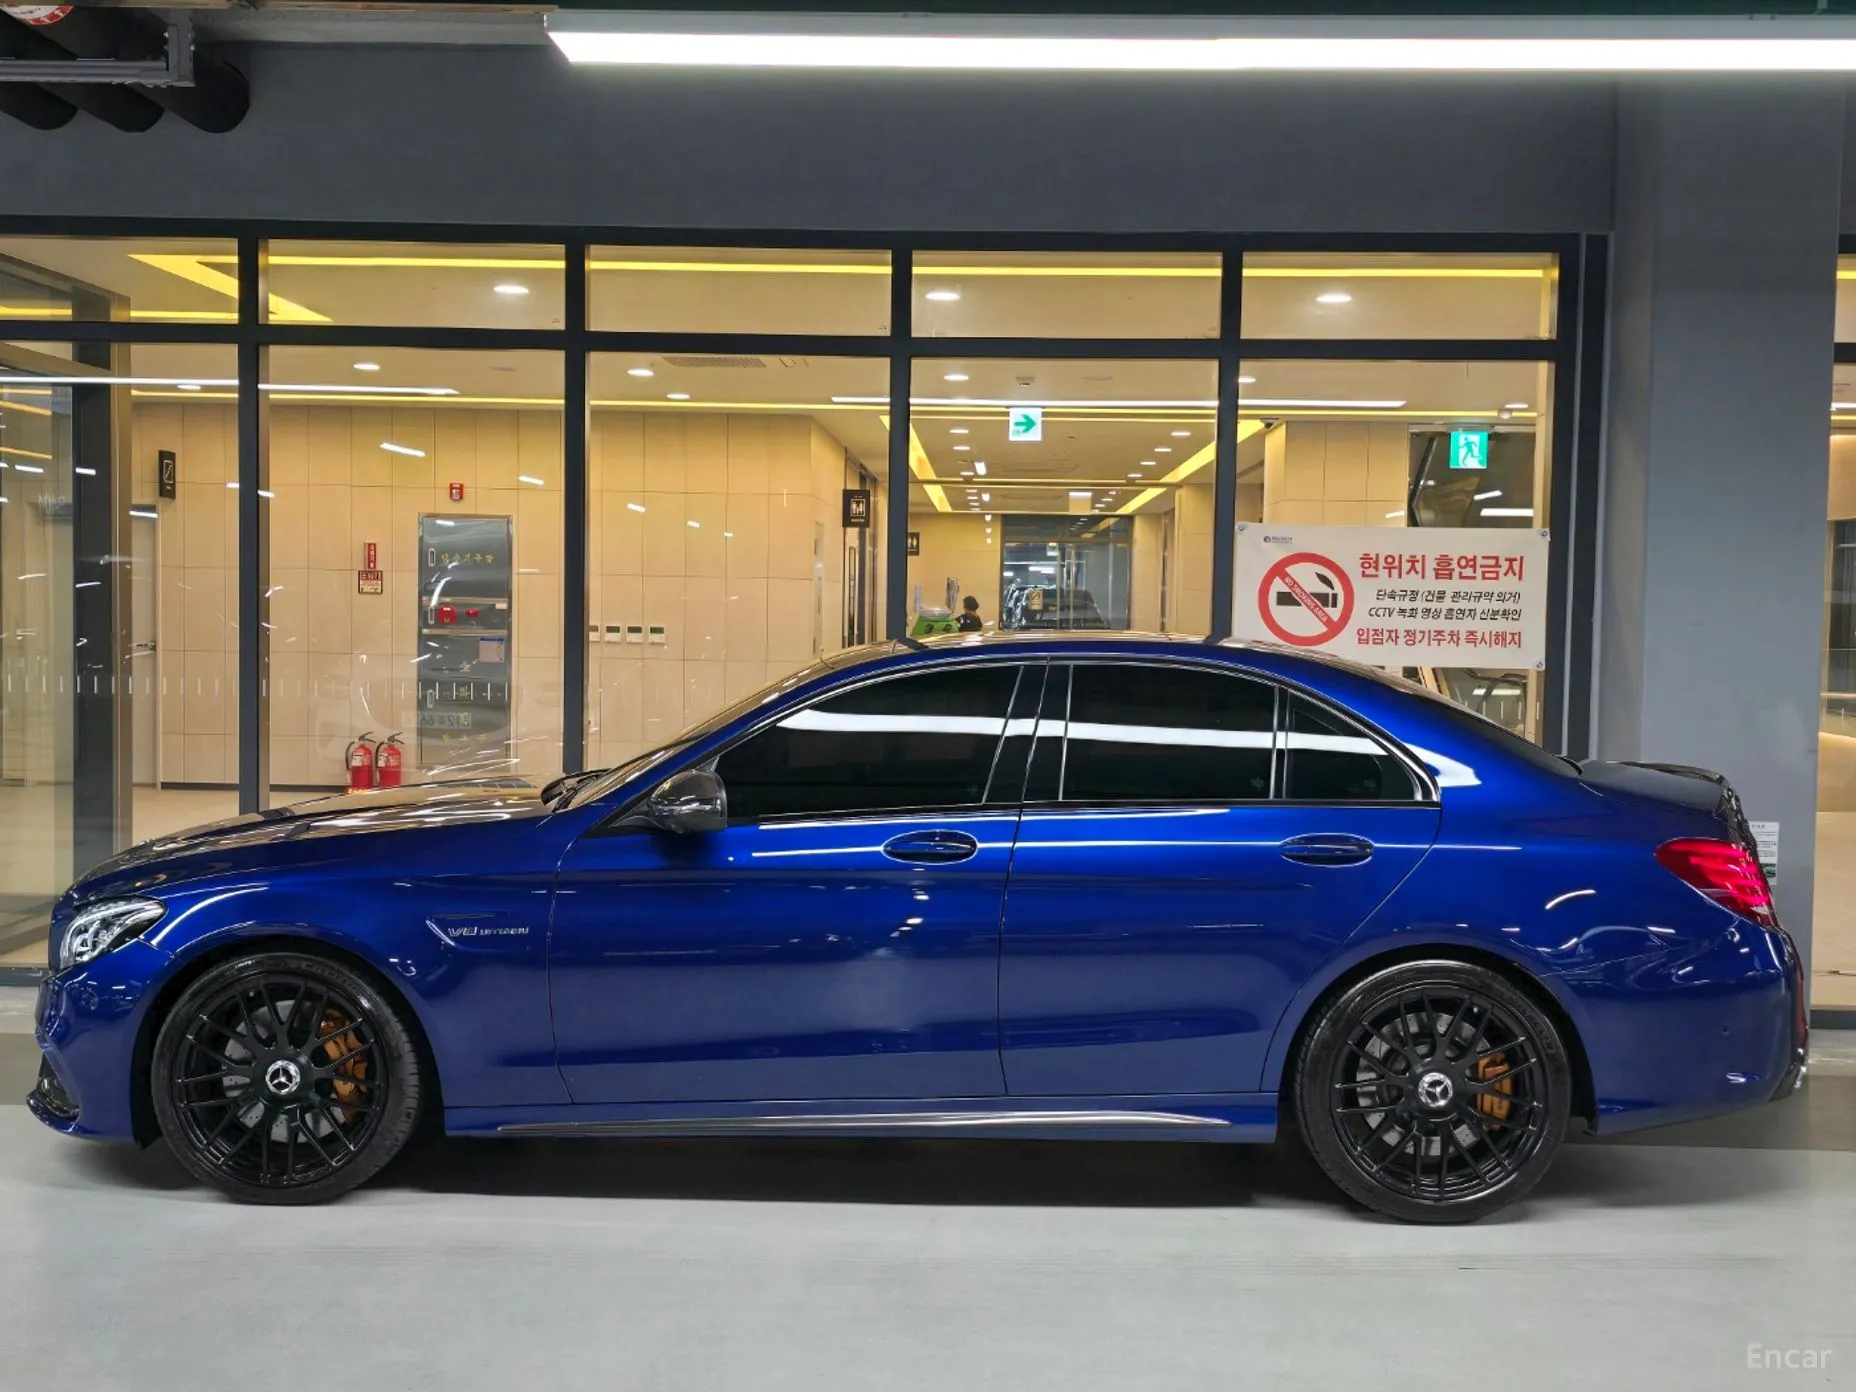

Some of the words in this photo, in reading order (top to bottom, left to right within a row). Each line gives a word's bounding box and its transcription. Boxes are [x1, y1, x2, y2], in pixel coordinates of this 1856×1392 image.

[1359, 553, 1426, 579] 현위치
[1433, 554, 1524, 581] 흡연금지
[1376, 589, 1419, 602] 단속규정
[1450, 590, 1494, 603] 관리규약
[1368, 607, 1395, 618] CCTV
[1397, 607, 1418, 619] 녹화
[1421, 607, 1442, 620] 영상
[1479, 608, 1522, 621] 신분확인
[1356, 628, 1400, 646] 입점자
[1403, 629, 1460, 648] 정기주차
[1464, 630, 1522, 649] 즉시해지
